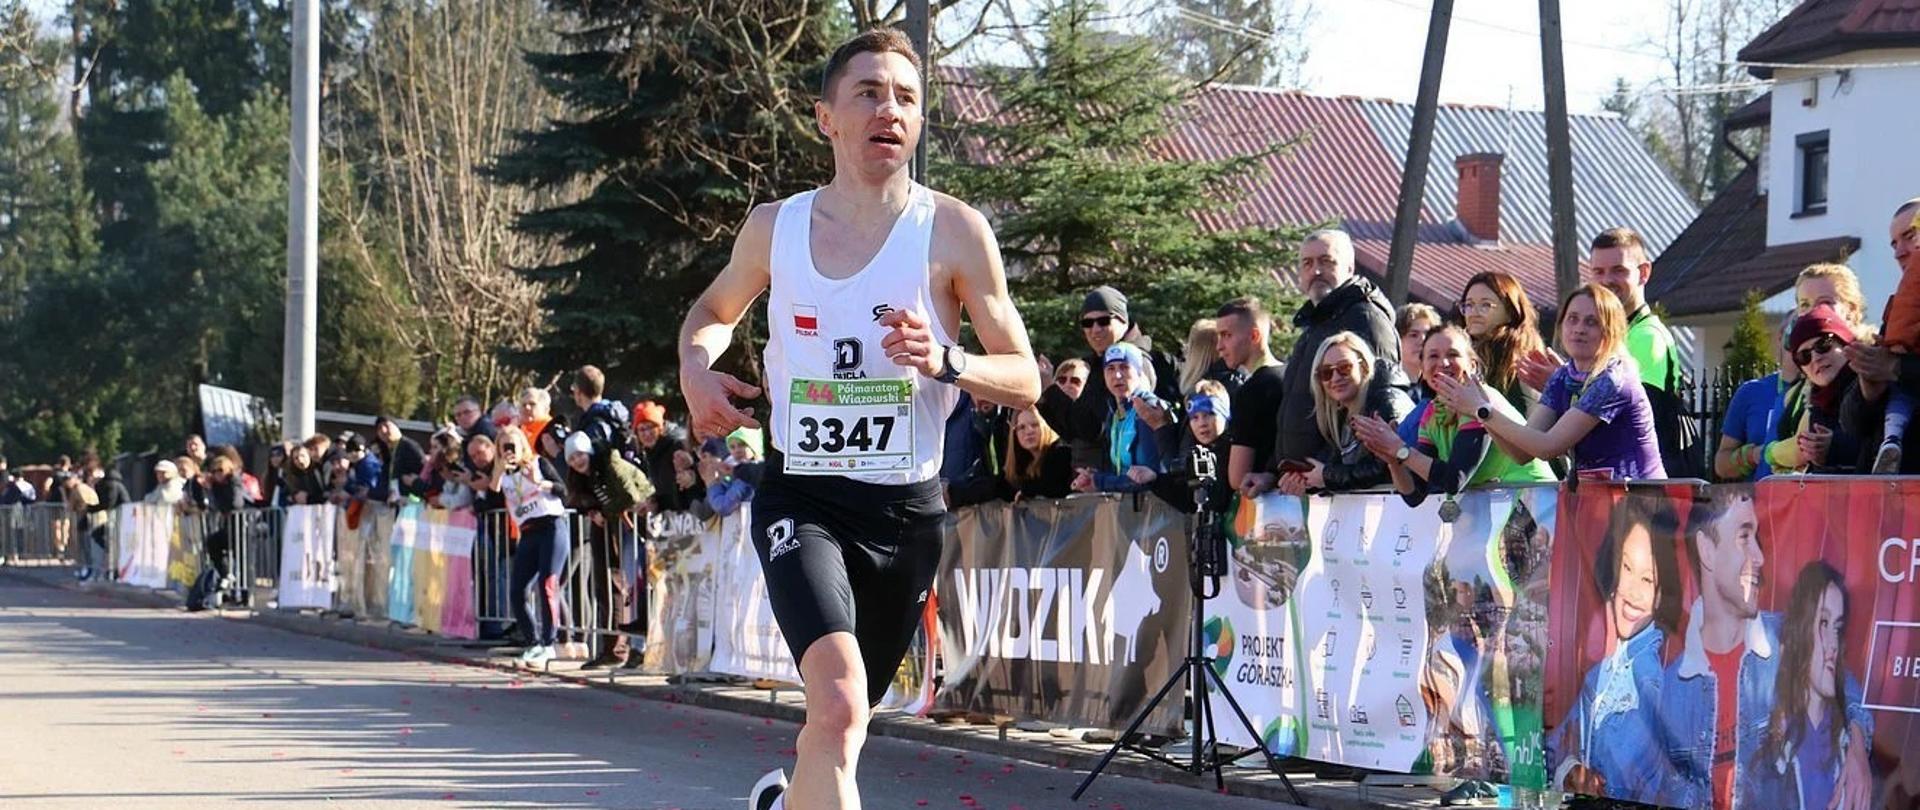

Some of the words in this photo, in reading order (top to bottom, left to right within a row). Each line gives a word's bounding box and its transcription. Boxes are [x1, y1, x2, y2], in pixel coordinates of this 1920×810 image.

[806, 382, 835, 403] 44
[797, 416, 896, 453] 3347
[1241, 634, 1285, 659] PROJEKT
